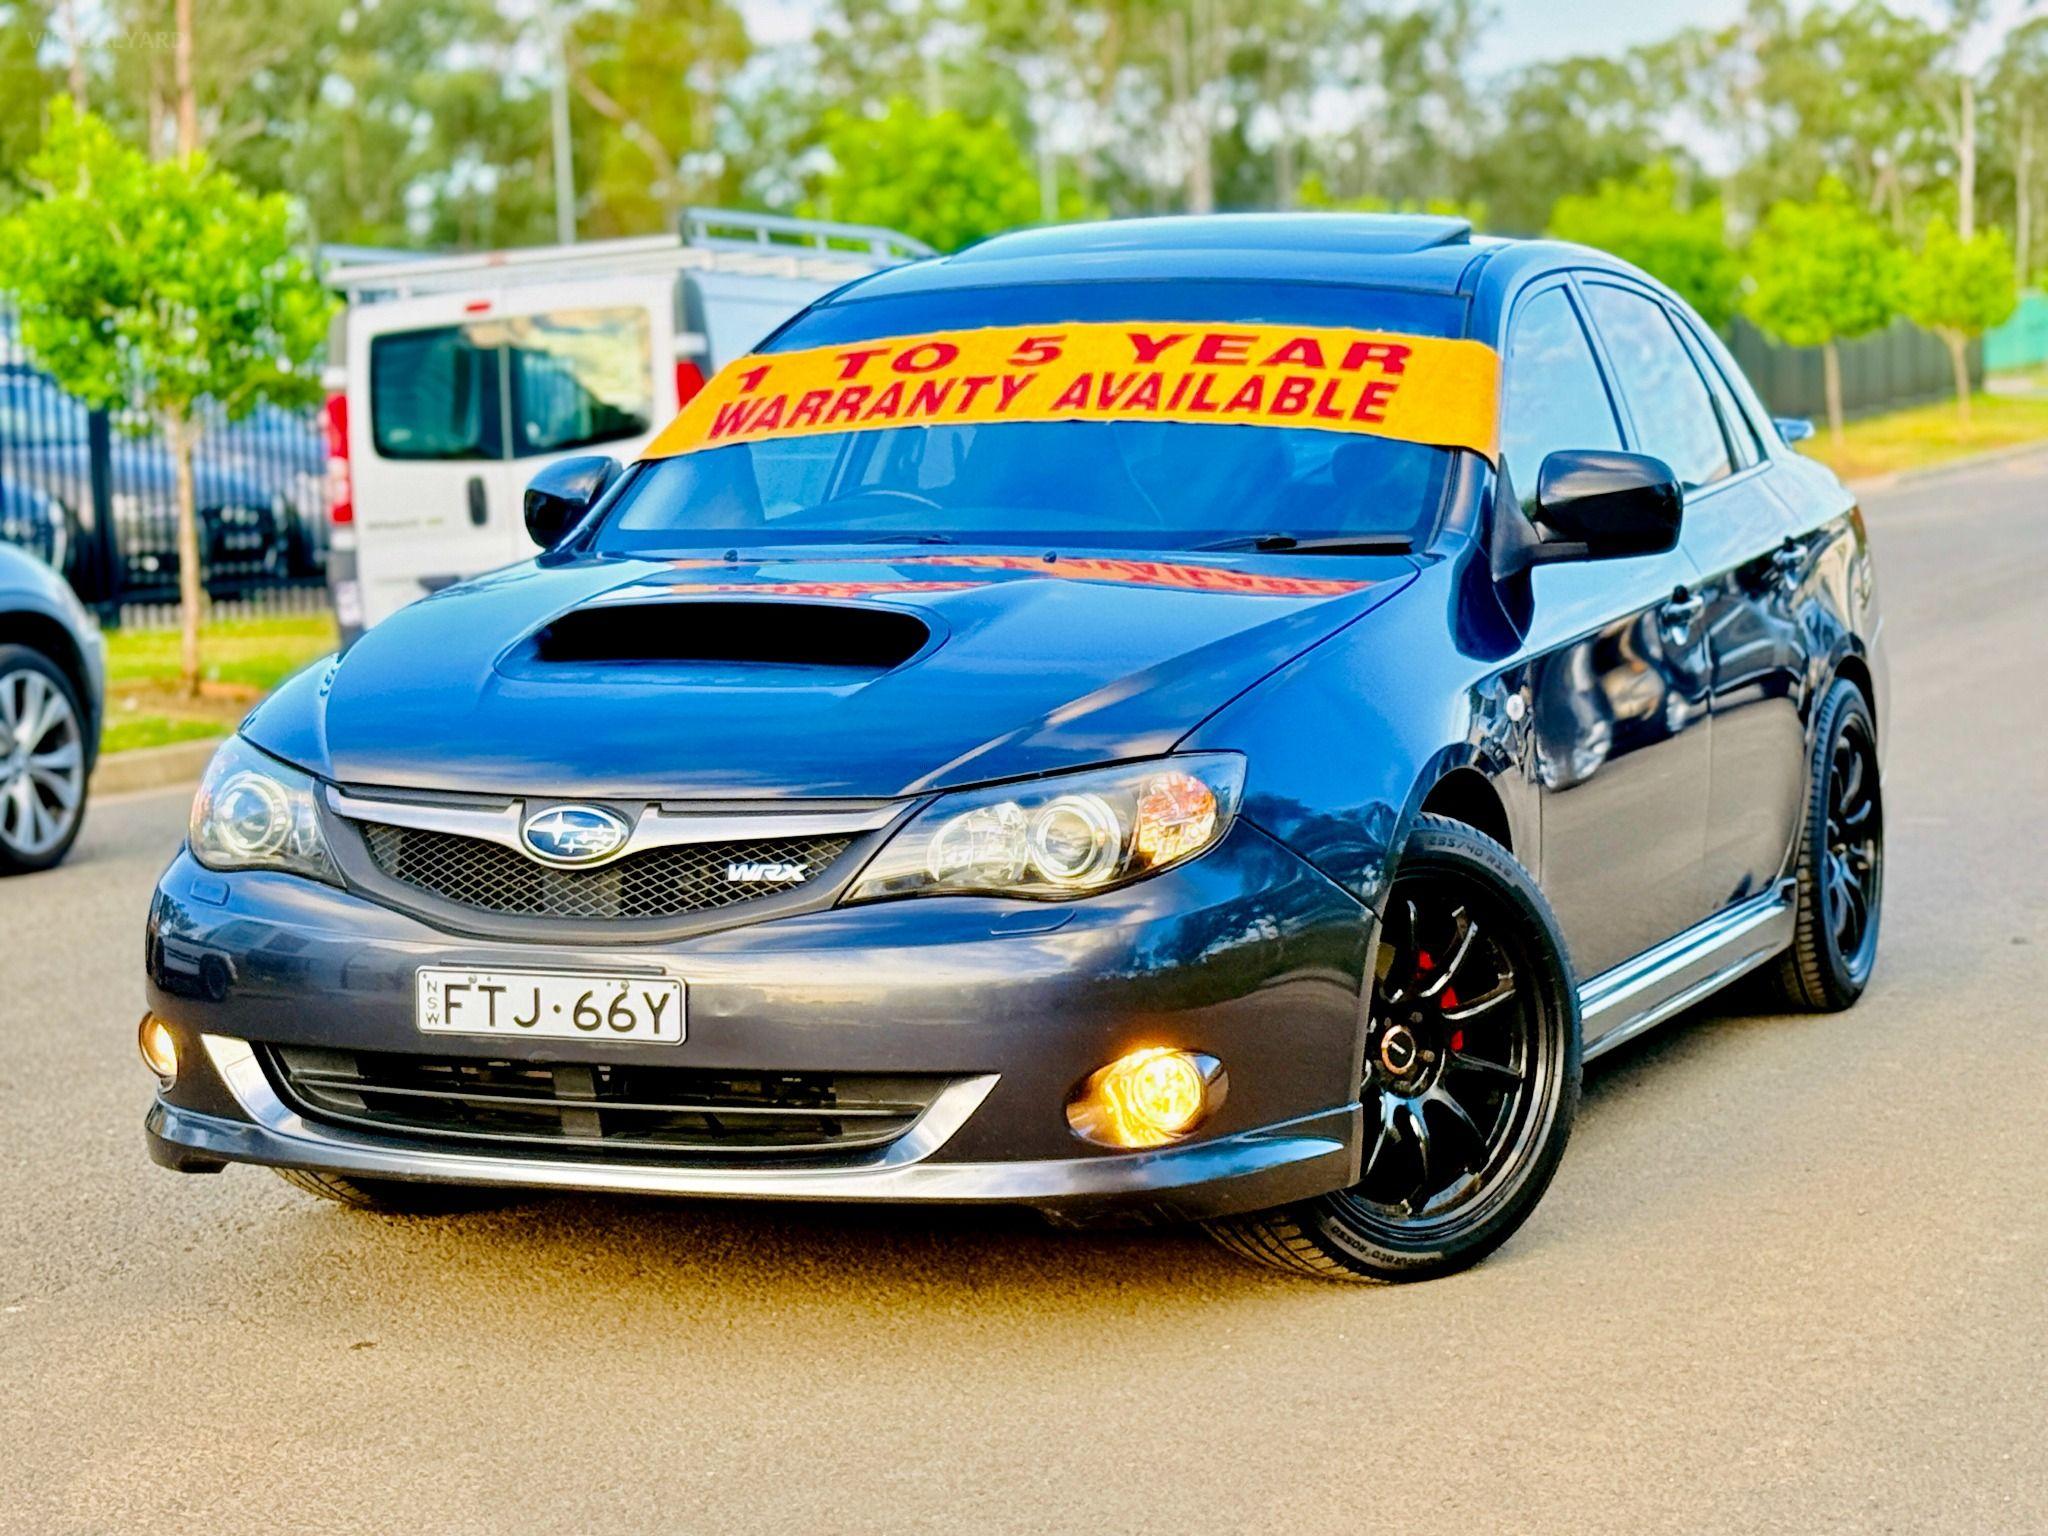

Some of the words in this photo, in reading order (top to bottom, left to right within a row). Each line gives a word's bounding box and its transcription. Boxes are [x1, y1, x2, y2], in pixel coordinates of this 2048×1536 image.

[738, 365, 773, 394] 1
[835, 342, 960, 380] TO
[1007, 335, 1068, 367] 5
[1127, 333, 1413, 375] YEAR
[707, 373, 1039, 440] WARRANTY
[1048, 372, 1402, 424] AVAILABLE
[727, 863, 808, 882] WRX
